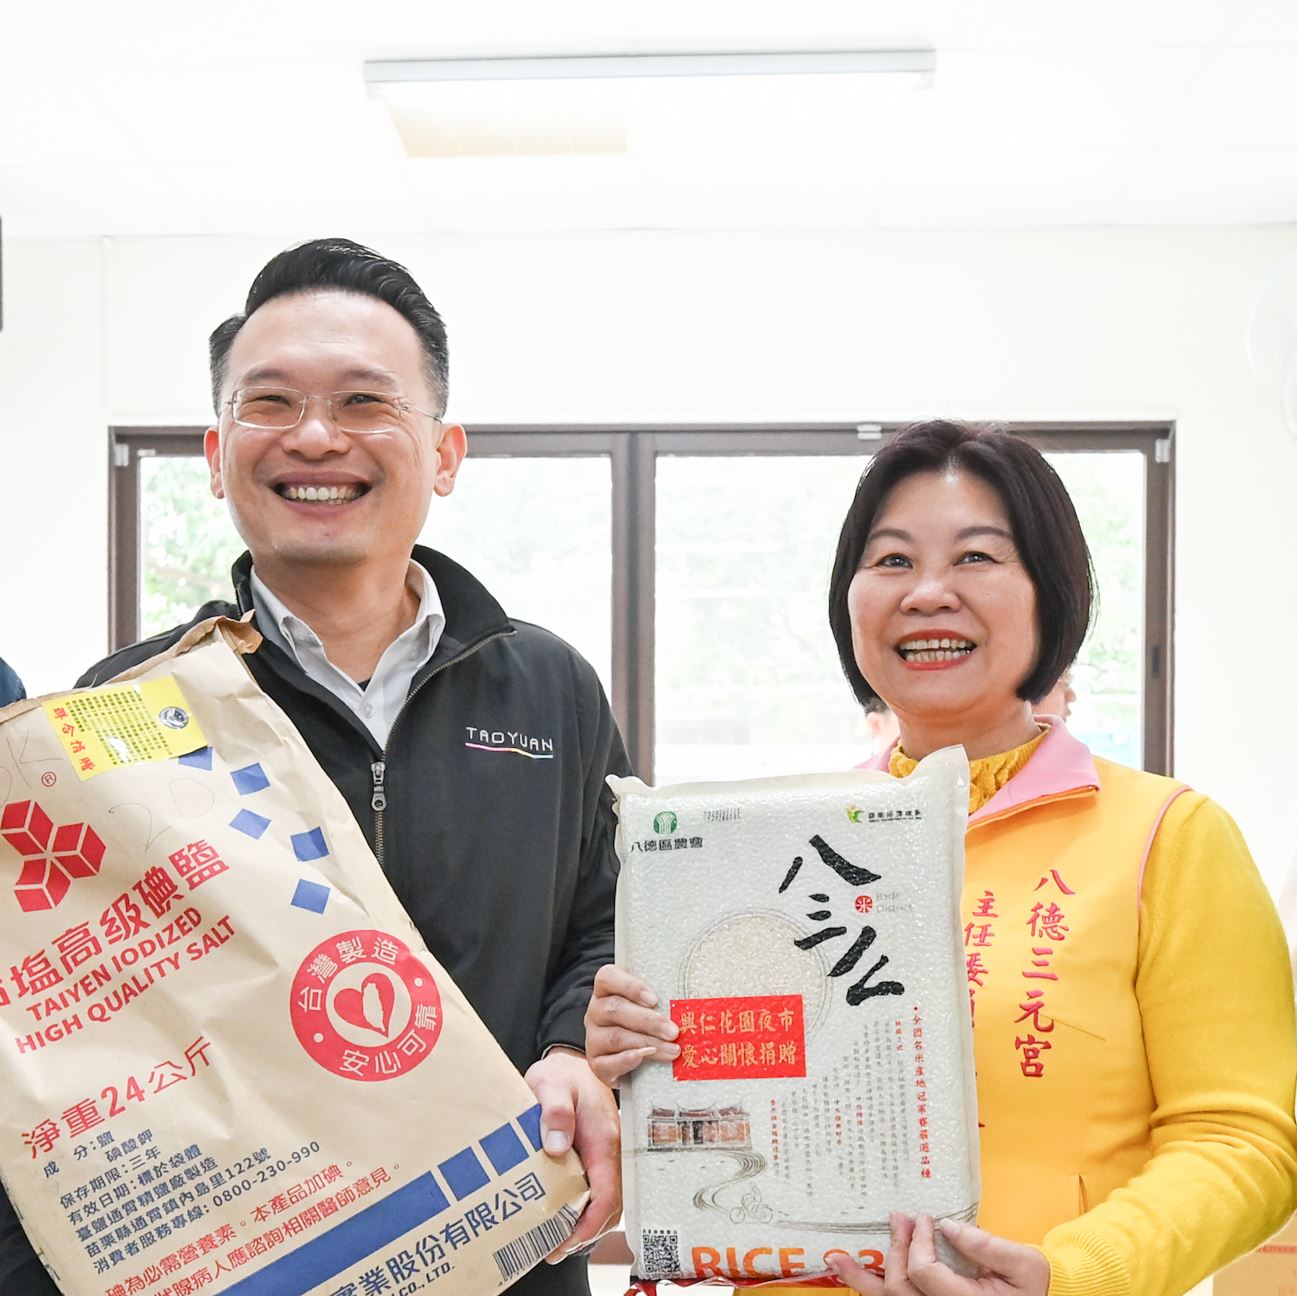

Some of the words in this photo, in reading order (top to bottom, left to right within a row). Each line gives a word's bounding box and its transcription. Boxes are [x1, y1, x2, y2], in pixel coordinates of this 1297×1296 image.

[466, 727, 553, 751] TAOYUAN
[14, 1012, 83, 1056] HIGH
[86, 952, 183, 1025] QUALITY
[185, 914, 238, 962] SALT
[25, 966, 113, 1021] TAIYEN
[110, 906, 203, 981] IODIZED
[298, 936, 399, 1012] 台灣製造
[963, 890, 999, 1028] 主任委
[1014, 869, 1076, 1078] 八德三元宮
[339, 1003, 438, 1077] 安心可靠
[21, 1035, 213, 1159] 淨重24公斤
[105, 1129, 154, 1163] 碘酸鉀
[212, 1141, 321, 1208] 0800-230-990
[425, 1263, 456, 1285] LTD.
[691, 1246, 805, 1279] RICE
